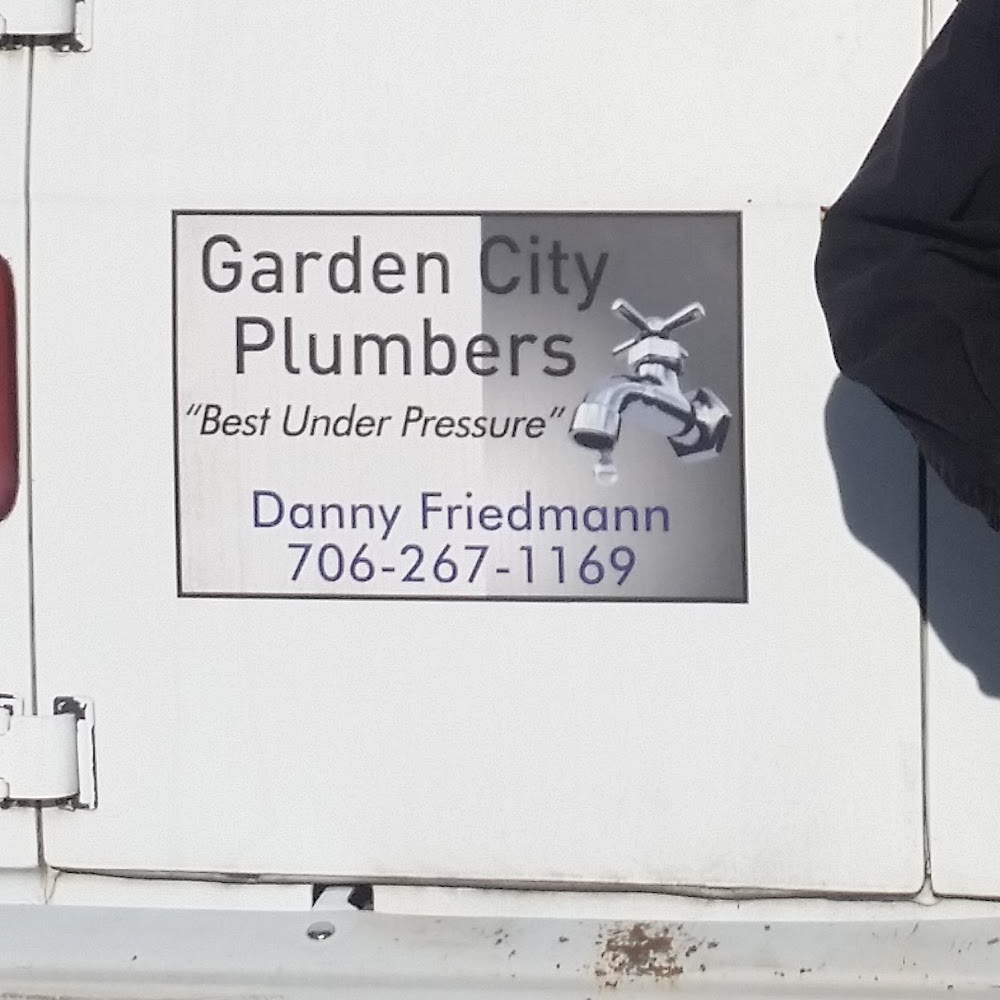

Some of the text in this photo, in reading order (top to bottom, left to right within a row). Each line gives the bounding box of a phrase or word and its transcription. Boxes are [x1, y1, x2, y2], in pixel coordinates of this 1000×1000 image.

[201, 234, 609, 311] Garden City
[235, 316, 576, 377] Plumbers
[282, 404, 392, 437] Under
[253, 490, 670, 540] Danny Friedmann
[288, 543, 637, 586] 706-267-1169
